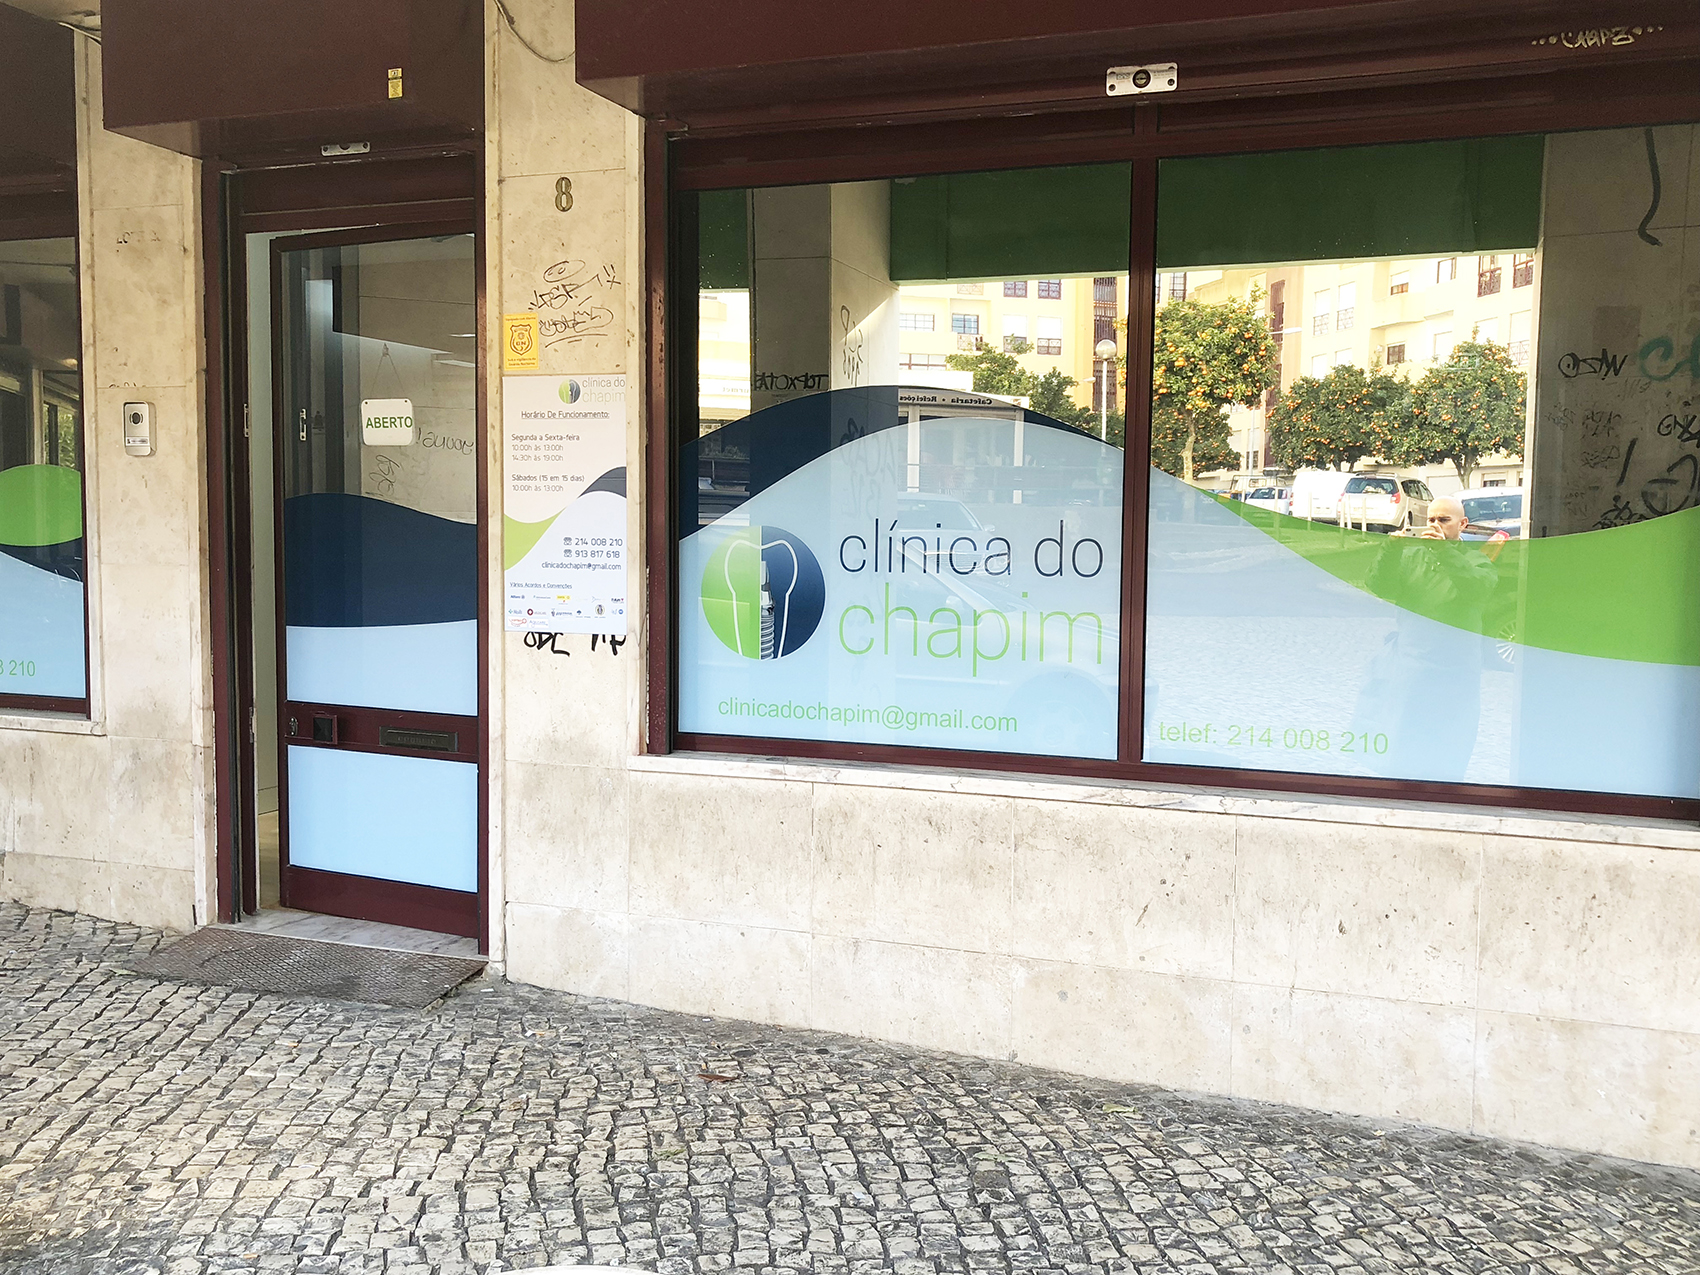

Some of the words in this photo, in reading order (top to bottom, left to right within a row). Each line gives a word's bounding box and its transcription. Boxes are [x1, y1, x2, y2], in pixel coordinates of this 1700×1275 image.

[554, 176, 574, 213] 8
[582, 377, 612, 388] clínica
[613, 377, 626, 388] do
[582, 389, 626, 405] chapim
[521, 410, 546, 419] Horário
[547, 410, 557, 419] De
[365, 416, 414, 429] ABERTO
[511, 433, 538, 443] Segunda
[544, 433, 580, 441] Sexta-feira
[511, 474, 538, 482] Sábados
[561, 474, 569, 482] 15
[574, 538, 588, 546] 214
[591, 538, 607, 547] 008
[609, 538, 623, 547] 210
[838, 517, 1013, 578] clínica
[1033, 518, 1104, 579] do
[574, 550, 588, 558] 913
[590, 550, 604, 558] 817
[606, 550, 620, 559] 618
[541, 561, 622, 571] clinicadochapim@gmail.com
[838, 582, 1103, 678] chapim
[8, 659, 36, 677] 210
[717, 697, 1018, 733] clinicadochapim@gmail.com
[1158, 721, 1217, 744] telef:
[1227, 724, 1274, 748] 214
[1283, 728, 1331, 751] 008
[1340, 731, 1389, 755] 210
